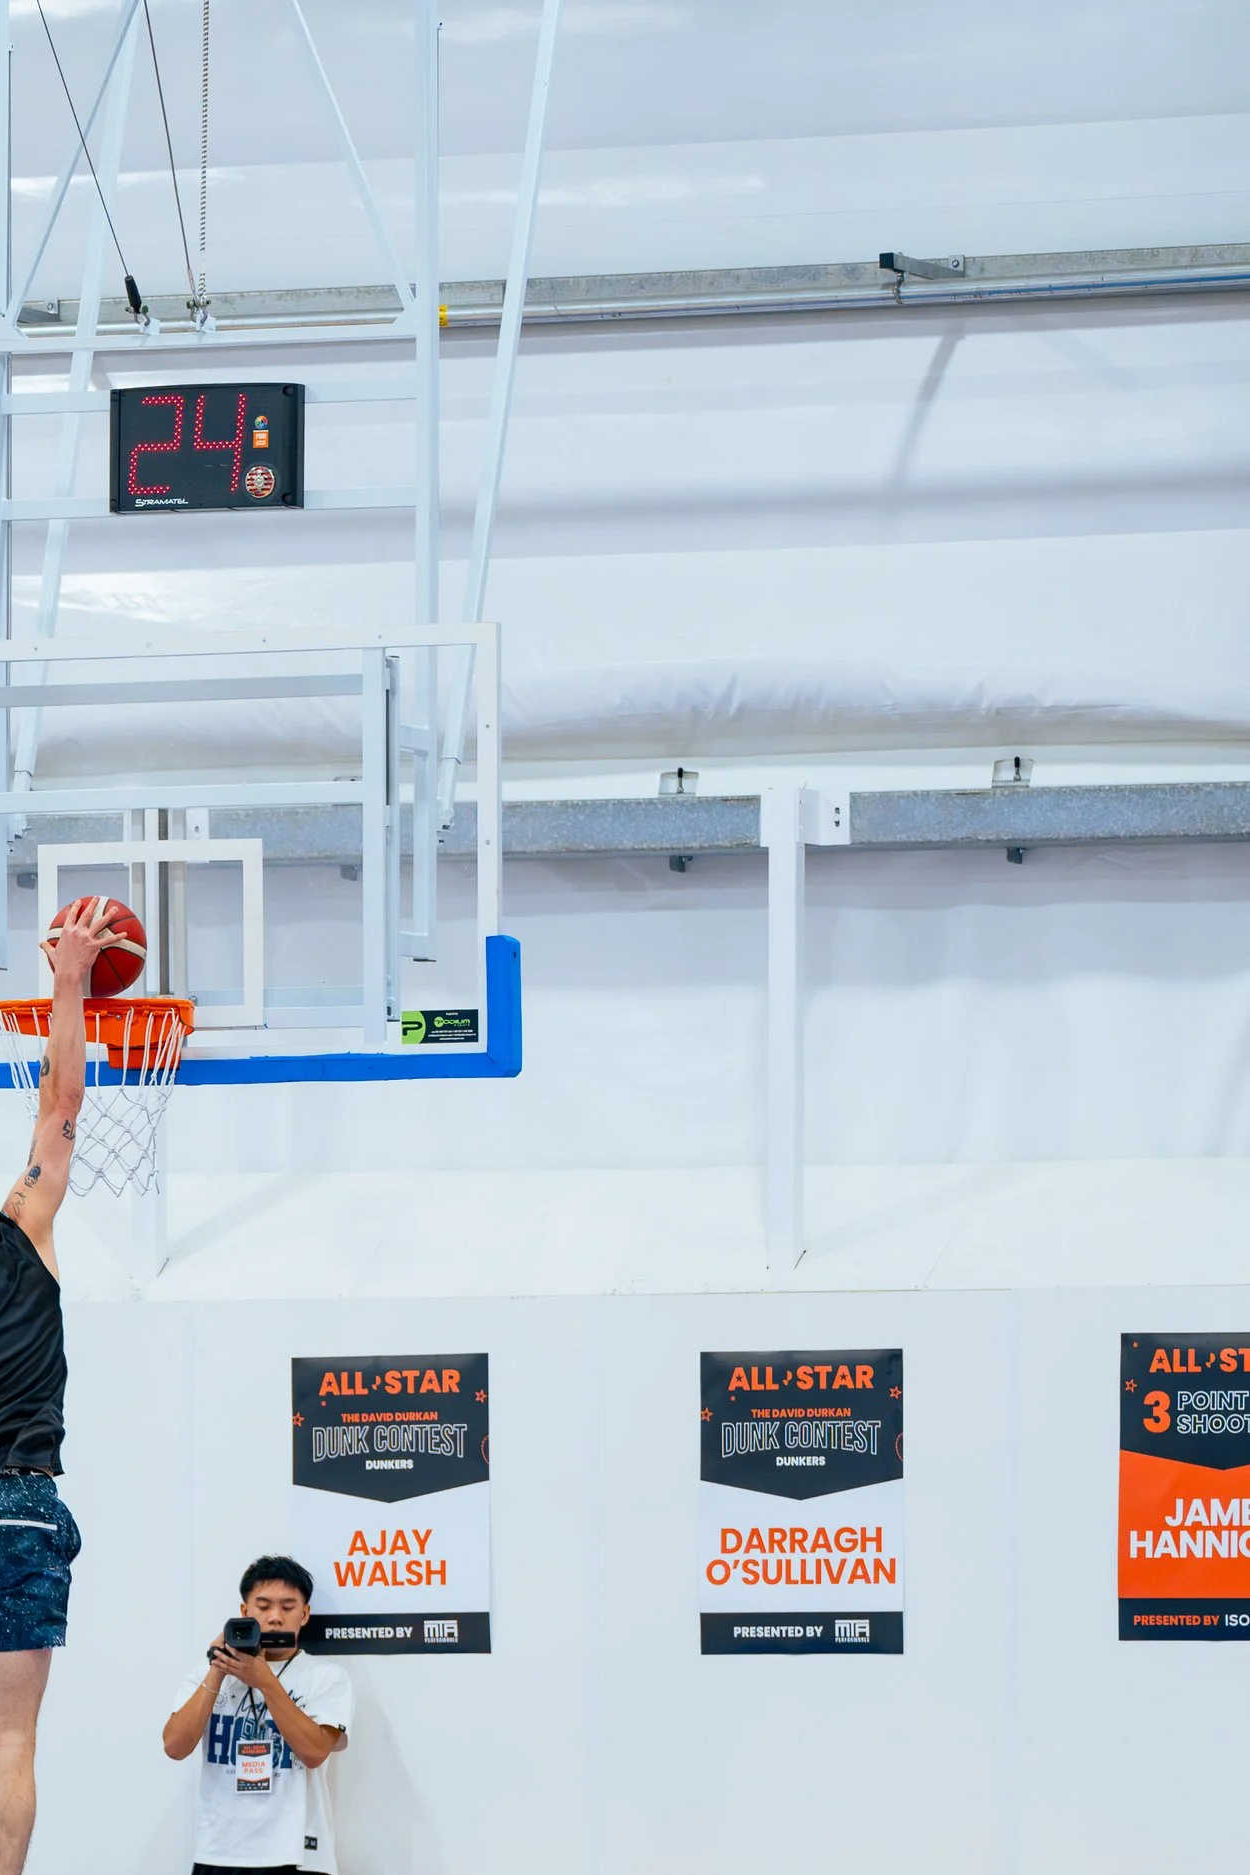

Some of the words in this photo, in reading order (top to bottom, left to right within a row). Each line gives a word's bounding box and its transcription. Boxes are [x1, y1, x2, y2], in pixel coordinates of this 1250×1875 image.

[128, 392, 246, 495] 24
[135, 498, 189, 507] STRAMATEL
[1149, 1348, 1202, 1373] ALL
[319, 1371, 369, 1396] ALL
[384, 1369, 460, 1394] STAR
[728, 1366, 779, 1391] ALL
[796, 1365, 874, 1390] STAR
[341, 1413, 361, 1423] THE
[361, 1412, 394, 1422] DAVID
[395, 1411, 438, 1421] DURKAN
[751, 1409, 770, 1418] THE
[772, 1408, 805, 1418] DAVID
[807, 1408, 851, 1417] DURKAN
[1143, 1390, 1171, 1433] 3
[1177, 1390, 1250, 1411] POINT
[312, 1425, 370, 1463] DUNK
[373, 1423, 467, 1458] CONTEST
[721, 1422, 780, 1458] DUNK
[784, 1420, 881, 1455] CONTEST
[365, 1459, 414, 1470] DUNKERS
[776, 1456, 826, 1466] DUNKERS
[347, 1529, 433, 1556] AJAY
[720, 1527, 882, 1554] DARRAGH
[333, 1560, 446, 1587] WALSH
[706, 1557, 896, 1585] O'SULLIVAN
[325, 1627, 395, 1639] PRESENTED
[396, 1627, 413, 1638] BY
[733, 1626, 804, 1638] PRESENTED
[806, 1626, 823, 1637] BY
[1133, 1615, 1201, 1626] PRESENTED
[1203, 1615, 1220, 1626] BY
